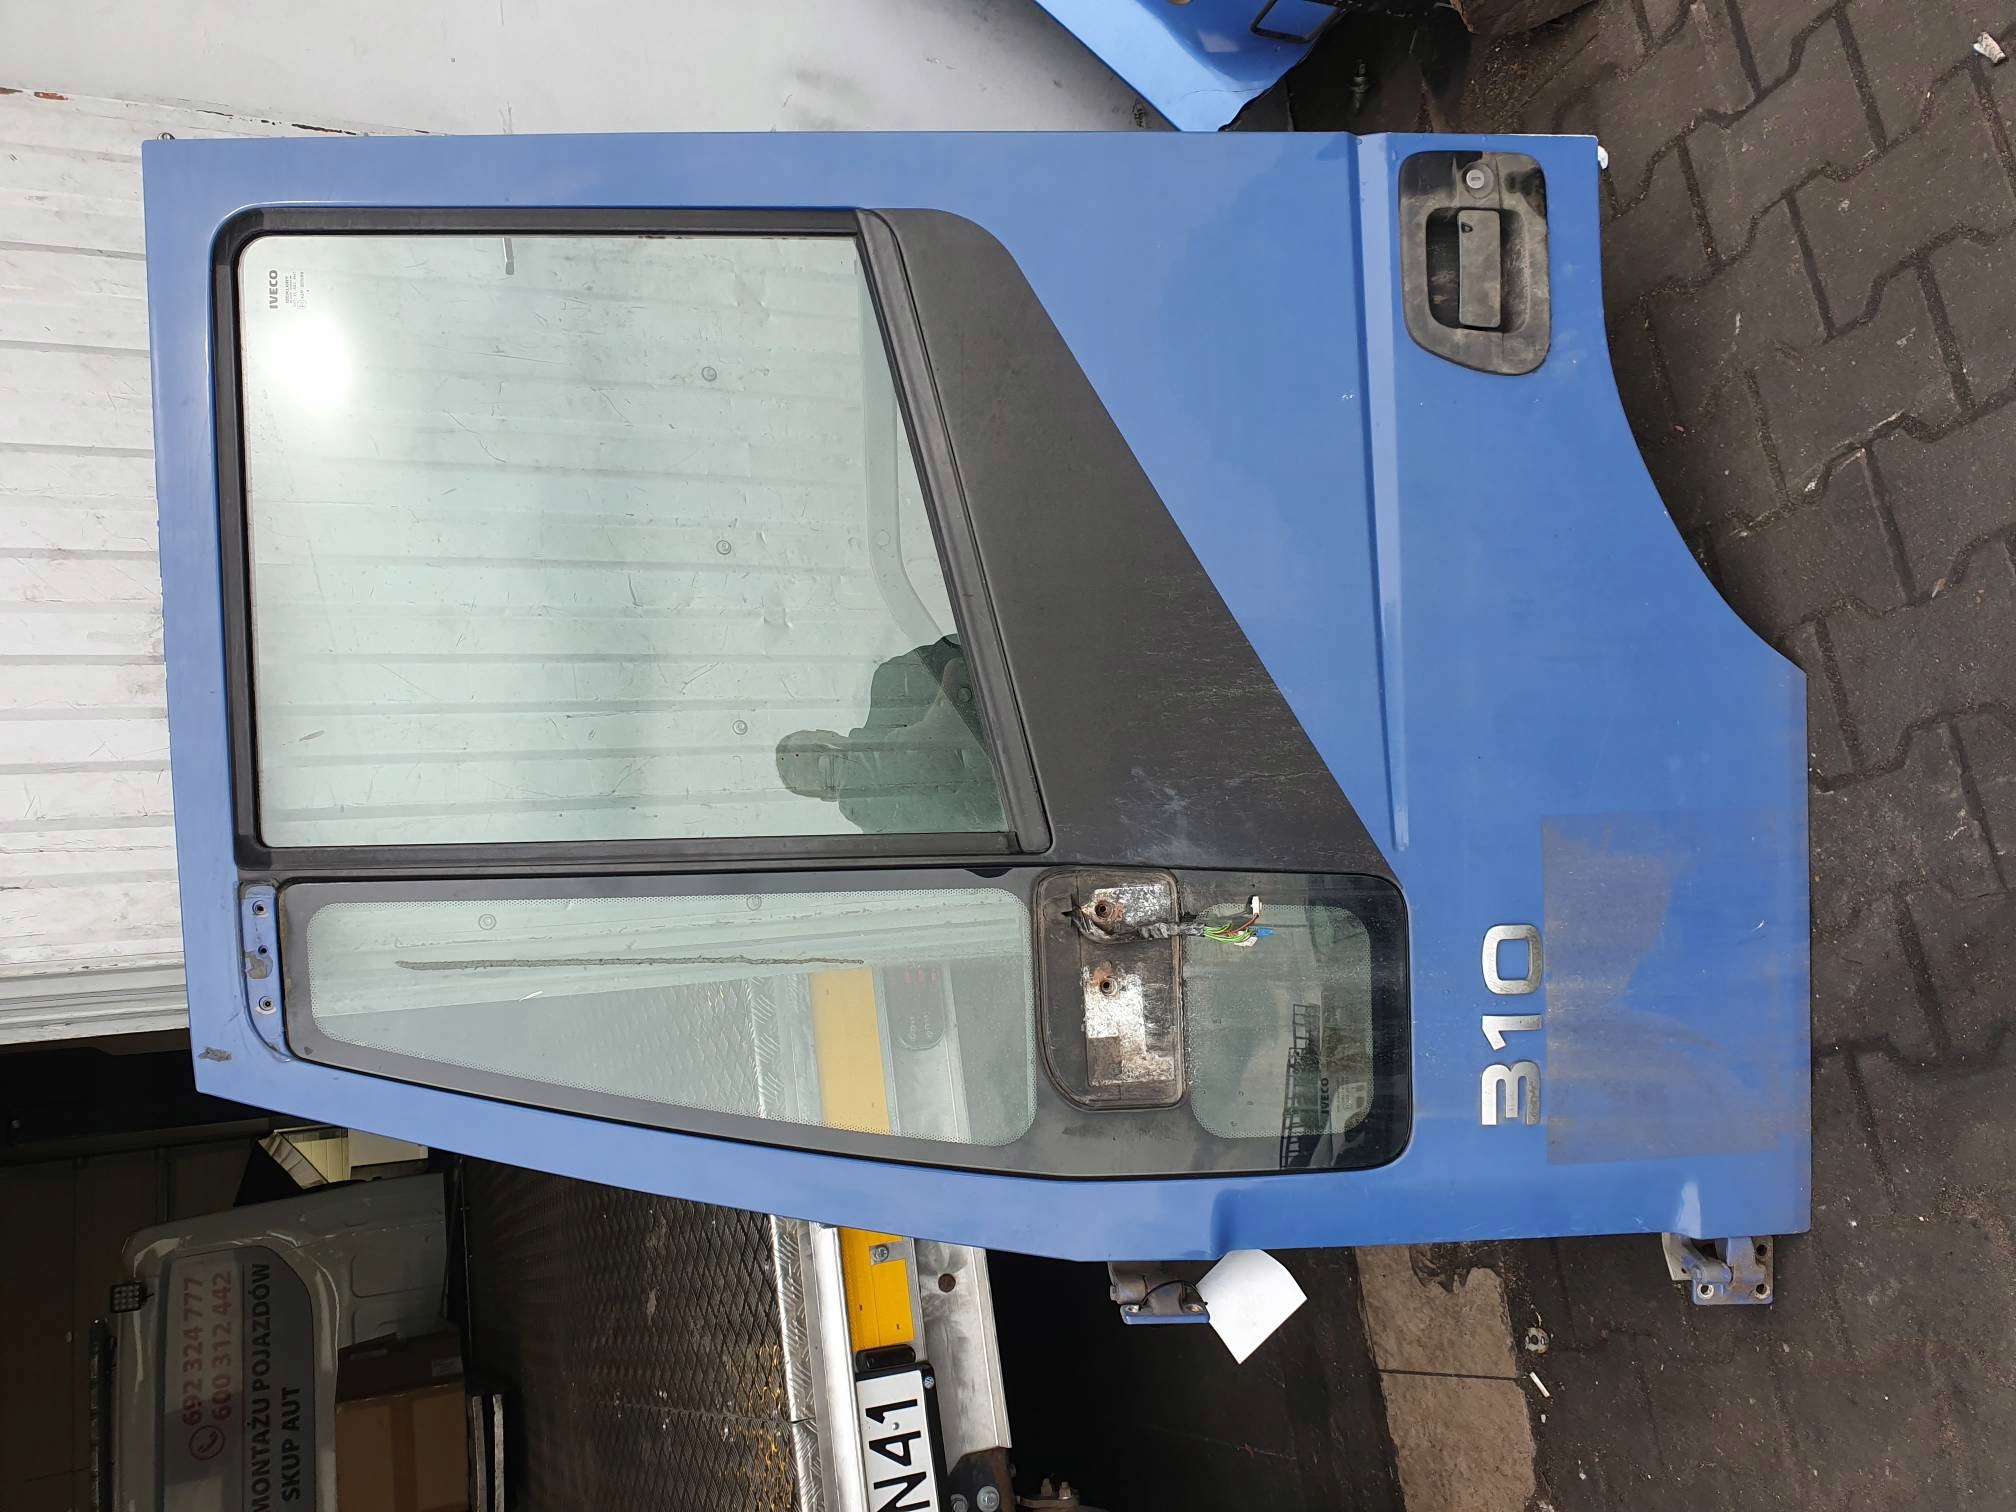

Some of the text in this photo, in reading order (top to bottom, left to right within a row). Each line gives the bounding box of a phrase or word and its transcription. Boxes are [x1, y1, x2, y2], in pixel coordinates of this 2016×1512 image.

[269, 270, 279, 309] IVECO
[1481, 923, 1543, 1126] 310
[1320, 1077, 1330, 1114] IVECO
[182, 1276, 203, 1426] 692 324 777
[211, 1271, 232, 1421] 600 312 442
[247, 1263, 271, 1392] POJAZDÓW
[281, 1386, 301, 1502] SKUP AUT
